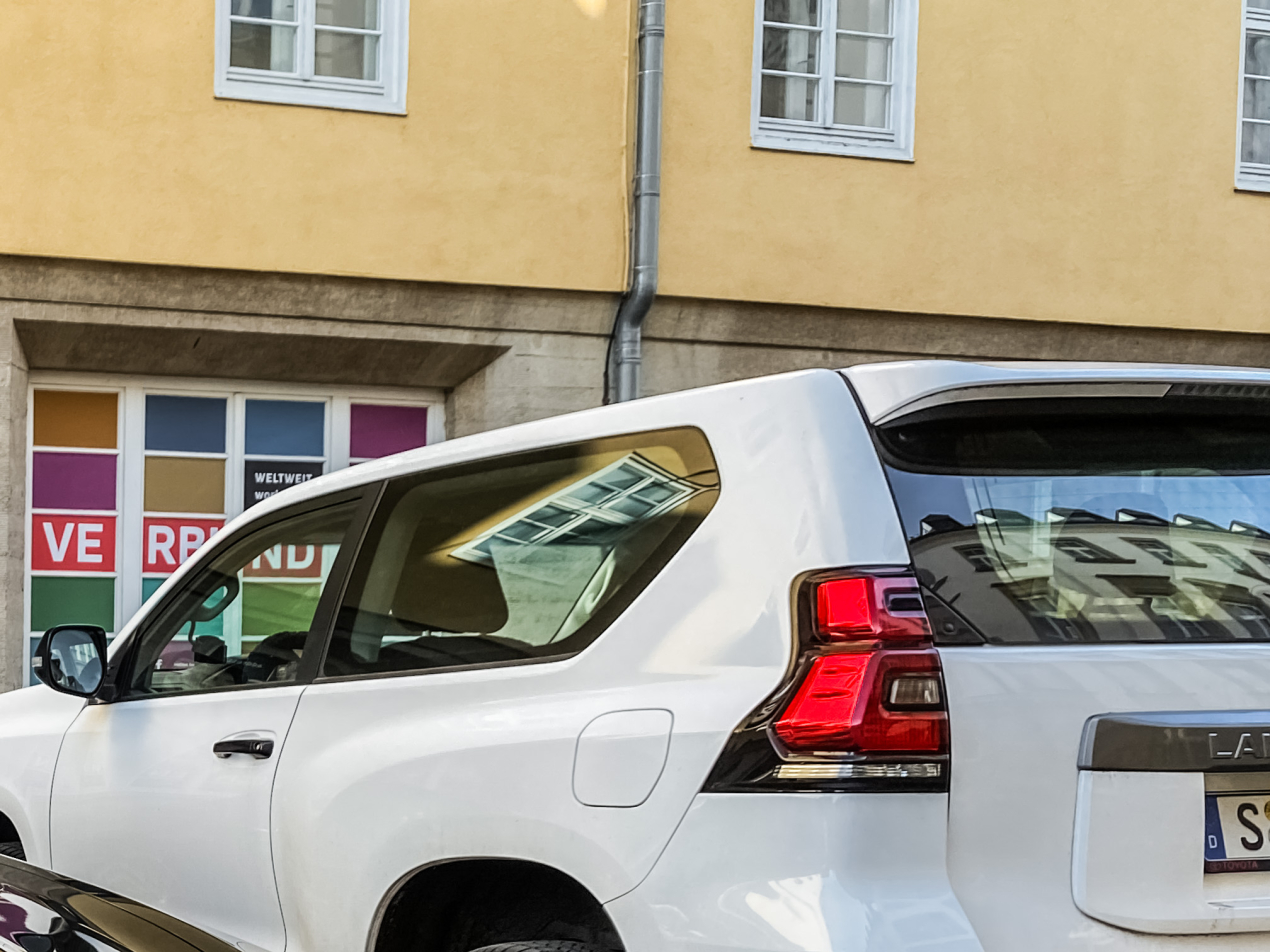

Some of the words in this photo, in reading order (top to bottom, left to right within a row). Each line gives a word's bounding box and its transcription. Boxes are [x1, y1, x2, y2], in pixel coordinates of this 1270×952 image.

[254, 472, 313, 484] WELTWEIT
[42, 521, 104, 564] VE
[1208, 835, 1218, 849] D
[1237, 802, 1264, 852] S
[1222, 861, 1259, 870] TOYOTA
